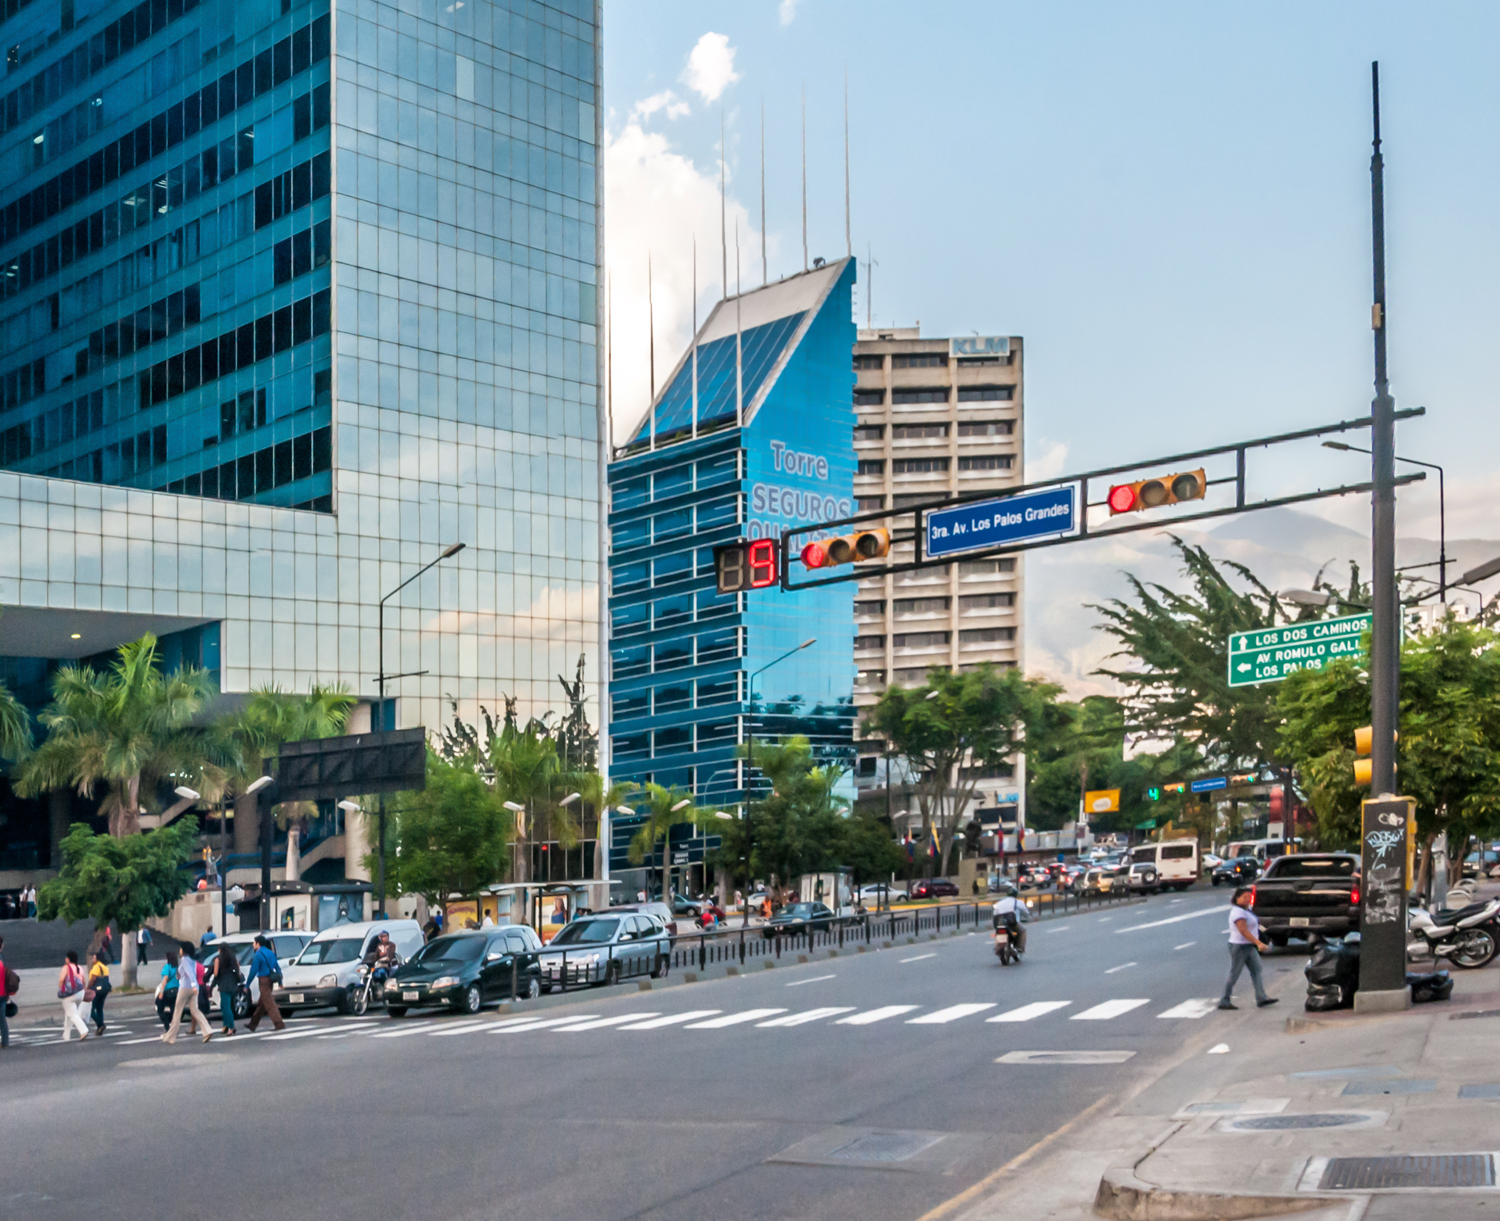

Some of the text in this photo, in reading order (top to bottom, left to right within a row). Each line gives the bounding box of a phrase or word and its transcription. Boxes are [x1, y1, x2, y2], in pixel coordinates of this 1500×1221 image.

[952, 337, 1008, 354] KLM
[770, 440, 828, 479] Torre
[752, 483, 851, 522] SEGUROS
[931, 503, 1069, 539] 3ra. Av. Los Palos Grandes
[749, 540, 775, 587] 9
[1255, 619, 1368, 646] LOS DOS CAMINOS
[1275, 644, 1325, 661] ROMULO
[1255, 665, 1278, 678] LOS
[1149, 787, 1160, 801] 4
